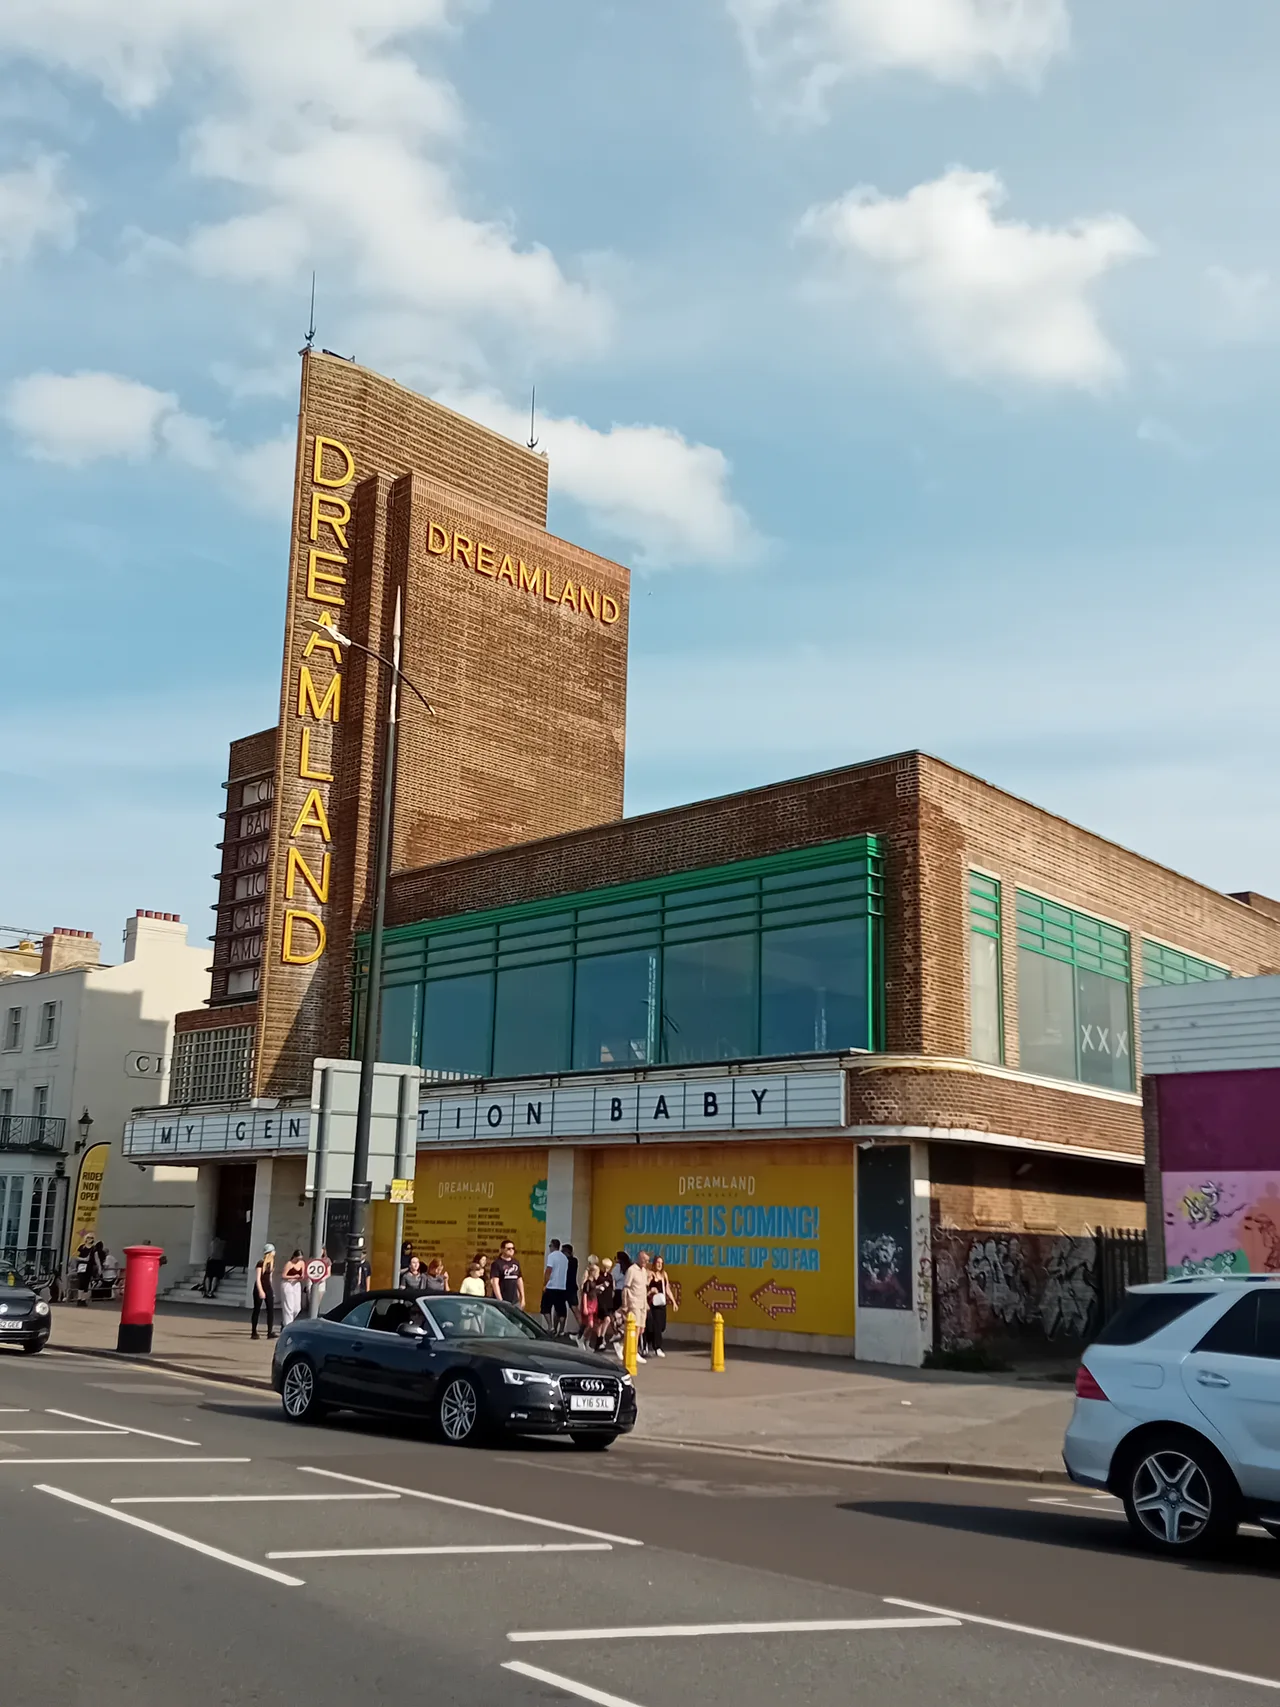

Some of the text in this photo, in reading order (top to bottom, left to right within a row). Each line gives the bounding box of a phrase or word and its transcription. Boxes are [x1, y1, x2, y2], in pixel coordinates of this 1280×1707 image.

[425, 520, 621, 625] DREAMLAND
[281, 435, 355, 965] DREAMLAND
[160, 1125, 194, 1144] MY
[236, 1118, 300, 1141] GEN
[611, 1088, 768, 1122] BABY
[438, 1181, 494, 1198] DREAMLAND
[678, 1175, 755, 1196] DREAMLAND
[624, 1204, 820, 1240] SUMMER IS COMING!
[309, 1265, 325, 1275] 20
[665, 1244, 690, 1265] OUT
[693, 1245, 715, 1267] THE
[718, 1246, 746, 1268] LINE
[749, 1247, 768, 1270] UP
[771, 1248, 789, 1271] SO
[791, 1249, 821, 1273] FAR
[576, 1397, 609, 1408] LY16 SXL
